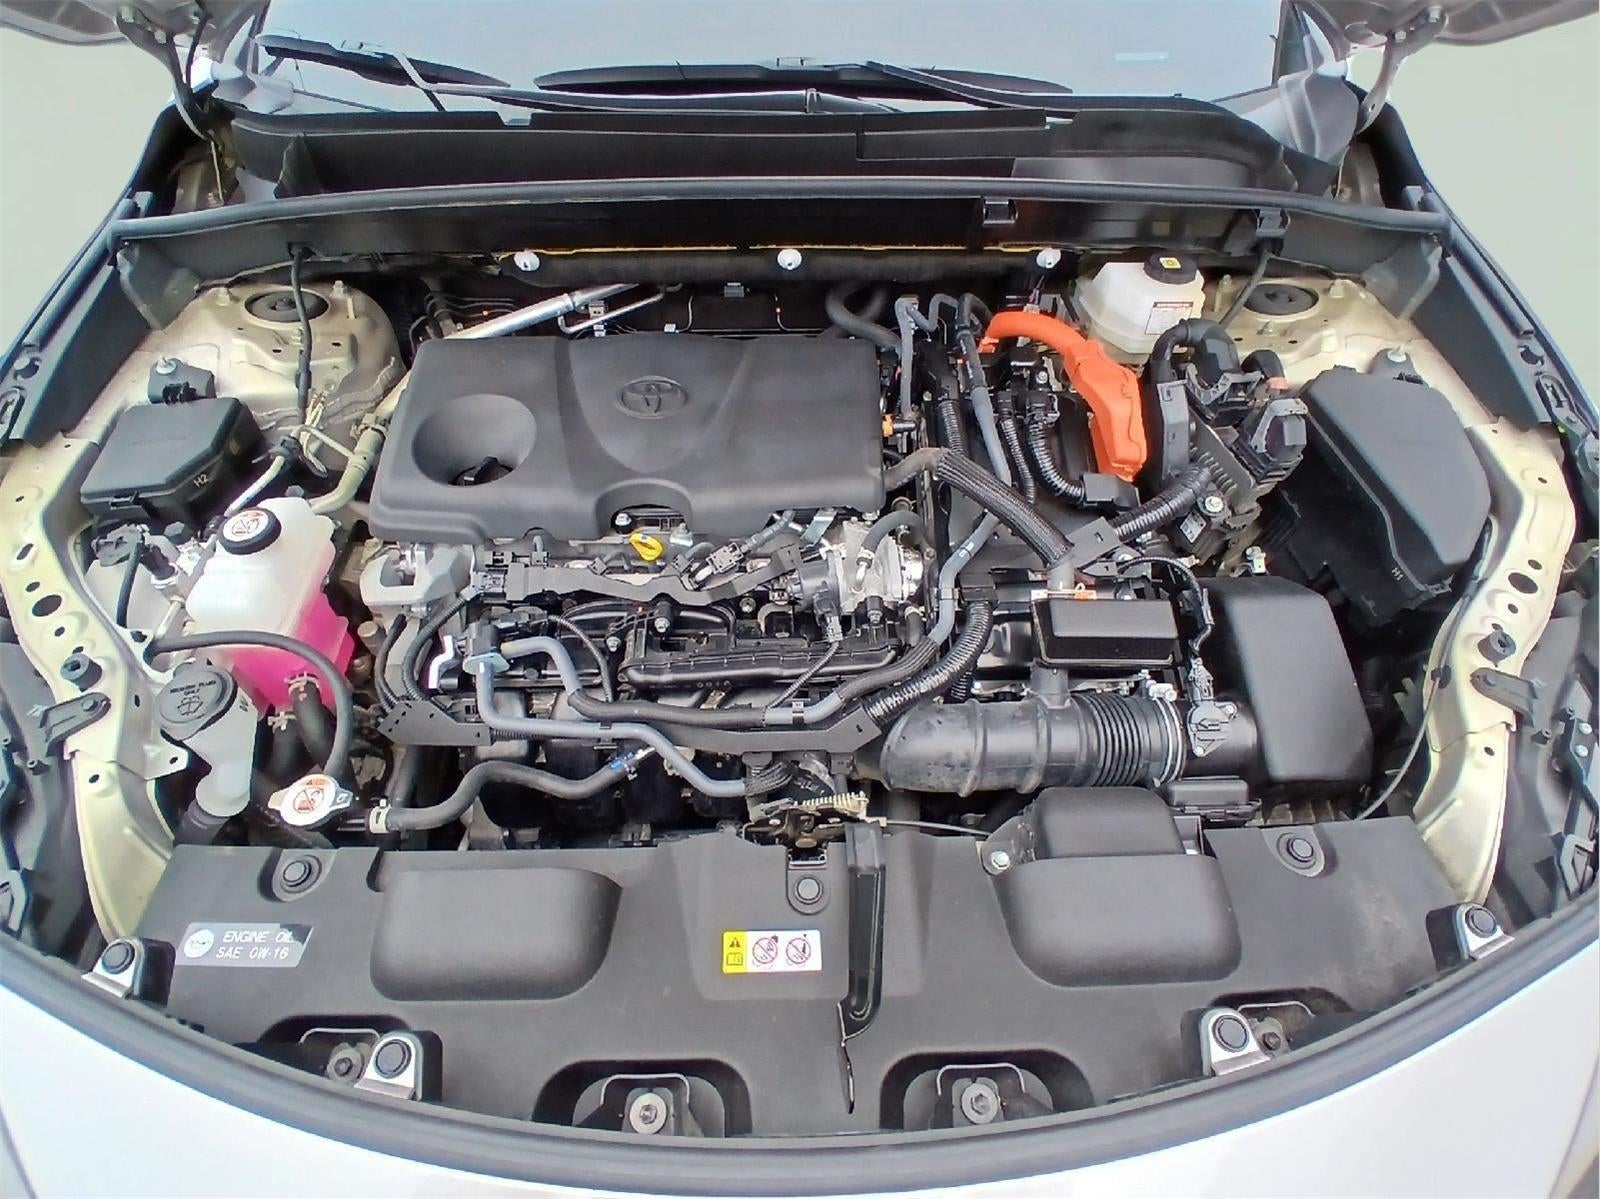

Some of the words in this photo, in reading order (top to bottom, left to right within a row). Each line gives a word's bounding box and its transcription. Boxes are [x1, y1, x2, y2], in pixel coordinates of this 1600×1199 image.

[193, 473, 209, 487] H2
[222, 930, 270, 943] ENGINE
[275, 930, 294, 943] OIL
[215, 946, 243, 959] SAE
